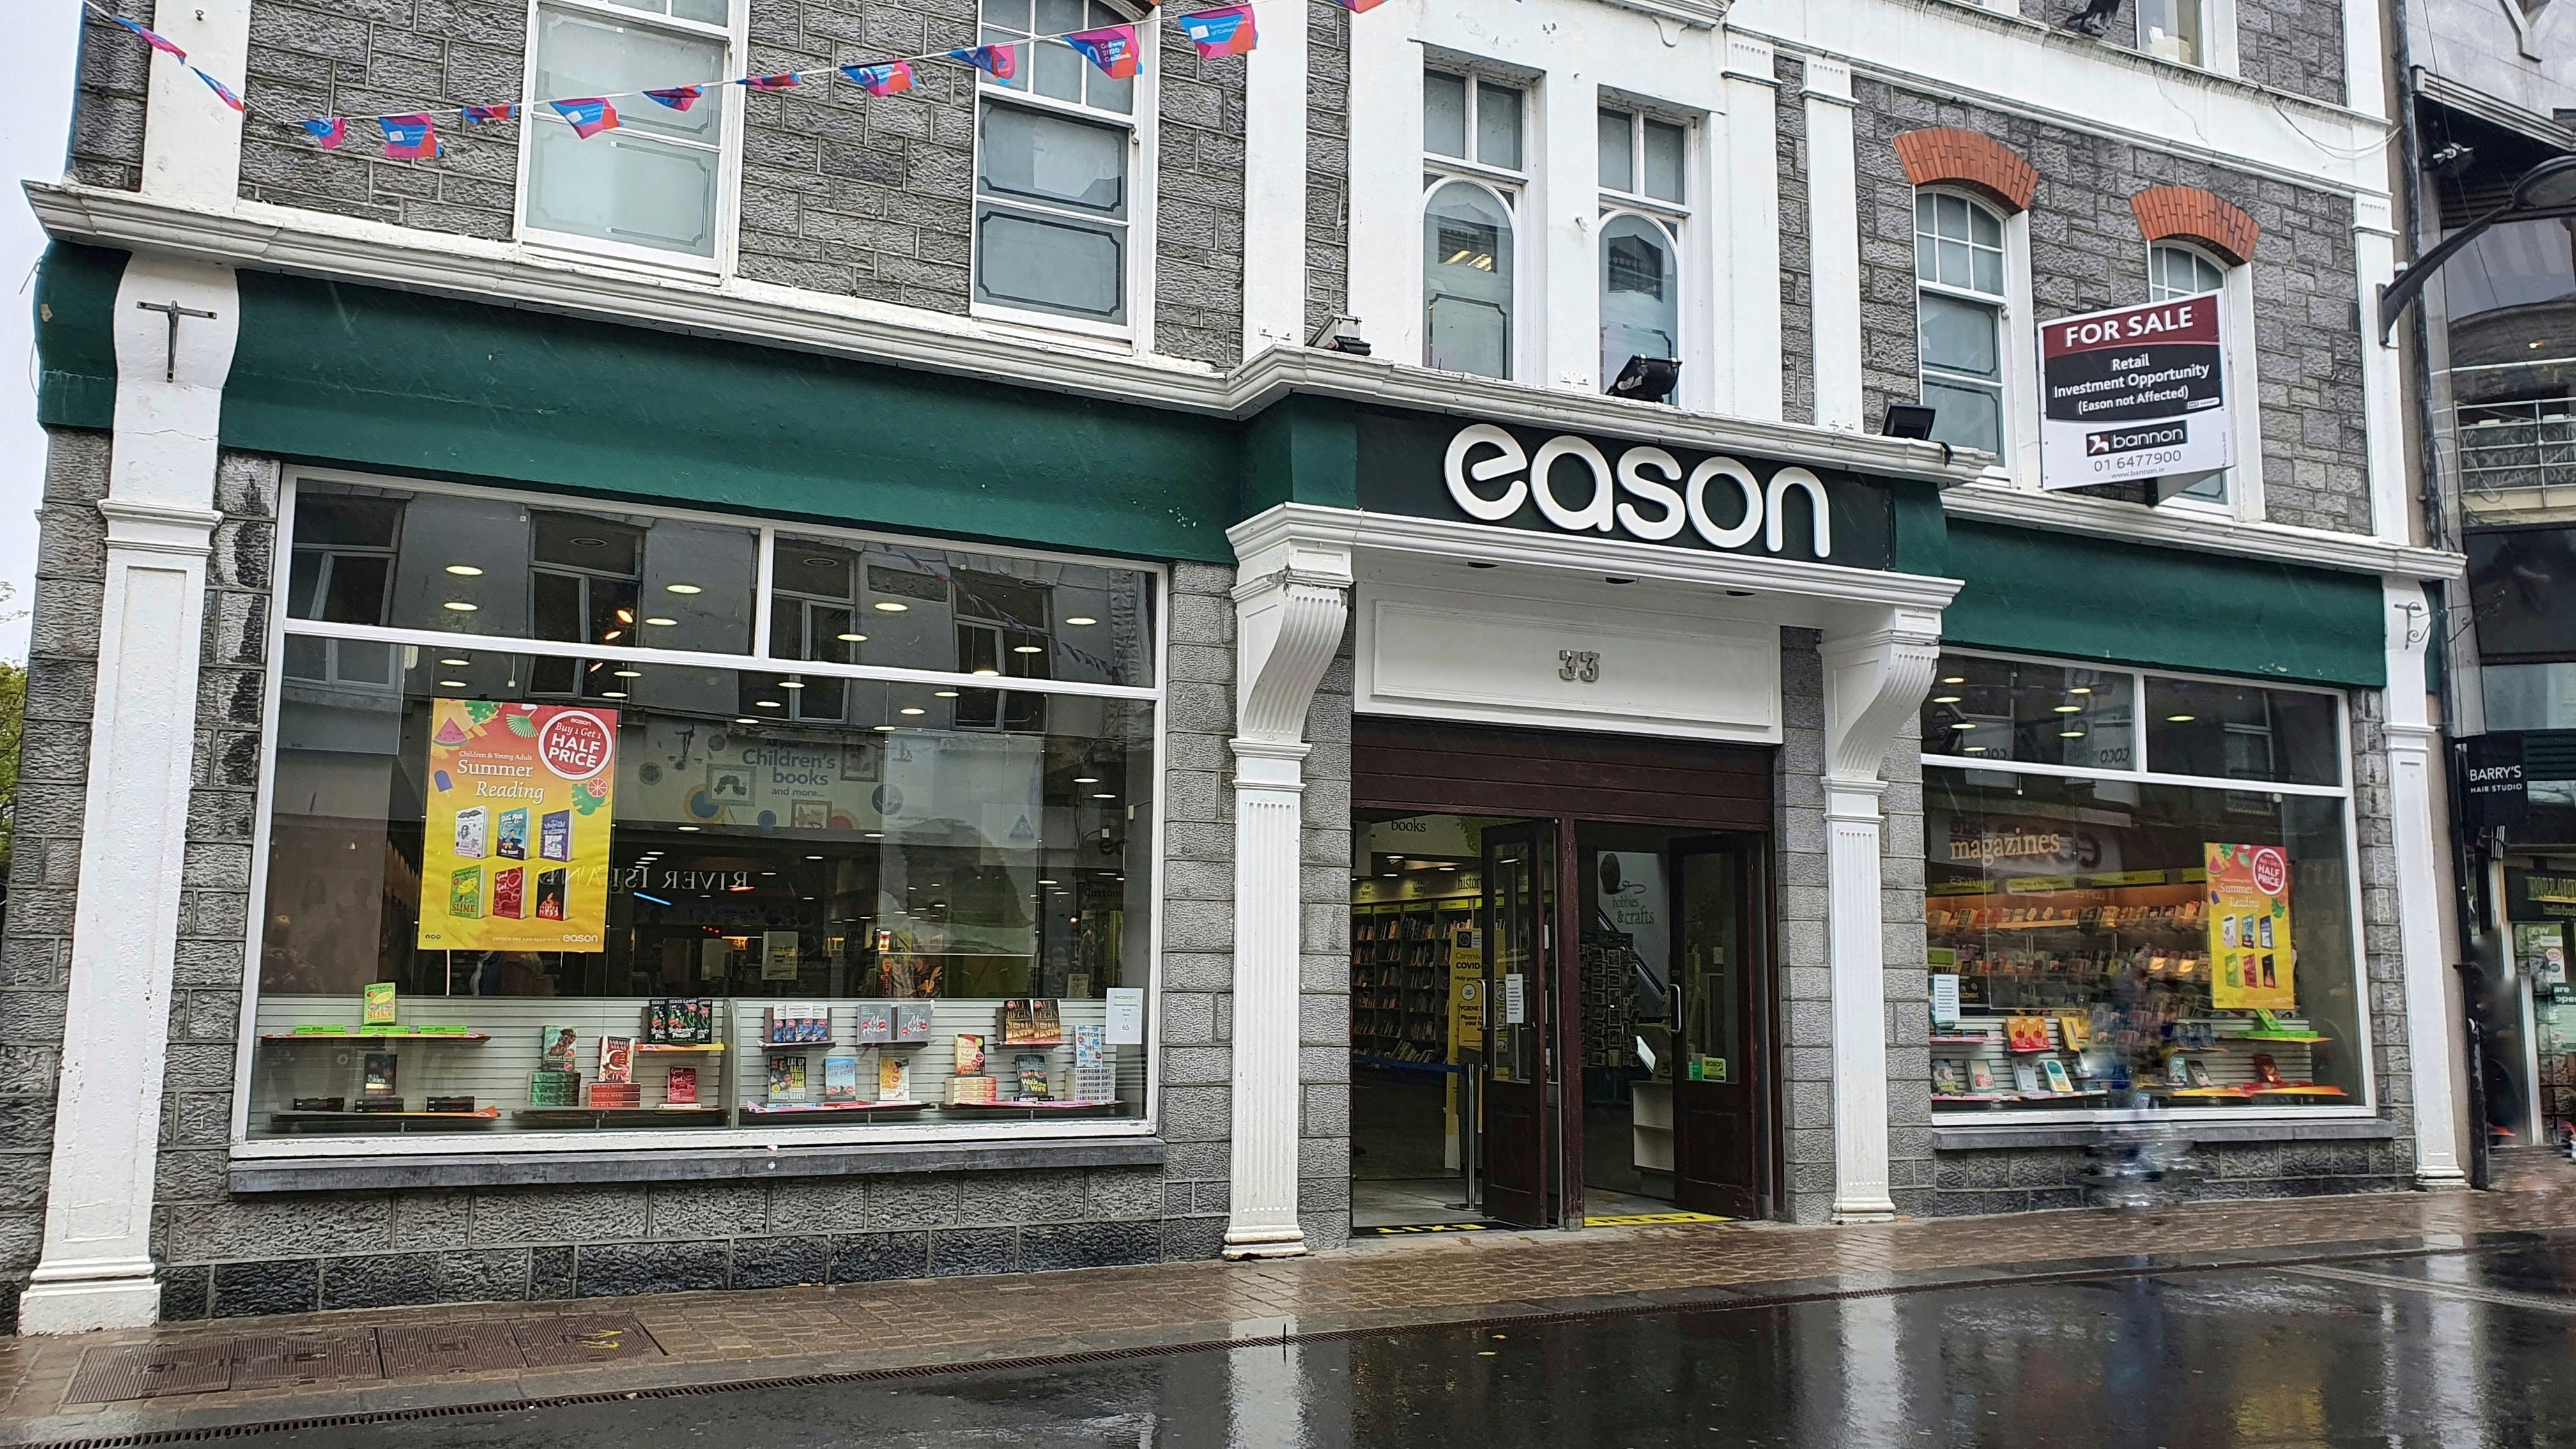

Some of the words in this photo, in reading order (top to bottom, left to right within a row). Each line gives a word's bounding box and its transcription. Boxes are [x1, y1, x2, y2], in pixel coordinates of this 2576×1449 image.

[1100, 40, 1126, 50] Galway
[2065, 320, 2120, 348] FOR
[2126, 306, 2194, 337] SALE
[2111, 353, 2150, 371] Retail
[2053, 376, 2124, 398] Investment
[2128, 364, 2210, 387] Opportunity
[2078, 395, 2113, 415] (Eason
[2115, 394, 2135, 406] not
[2137, 385, 2189, 403] Affected)
[2112, 427, 2184, 448] bannon
[2094, 459, 2110, 472] 01
[2117, 450, 2182, 470] 6477900
[2112, 466, 2165, 479] www.bannon.ie
[1445, 424, 1830, 558] eason
[1558, 649, 1600, 683] 33
[555, 722, 573, 735] Buy
[581, 728, 596, 738] Get
[551, 733, 601, 753] HALF
[494, 753, 514, 761] Young
[548, 747, 597, 768] PRICE
[742, 748, 836, 769] Children's
[457, 760, 533, 777] Summer
[773, 767, 829, 785] books
[2470, 765, 2522, 781] BARRY'S
[475, 781, 544, 804] Reading
[772, 786, 790, 796] and
[2471, 785, 2489, 793] HAIR
[2492, 783, 2522, 792] STUDIO
[1391, 818, 1426, 832] books
[1950, 827, 2060, 867] magazines
[2258, 864, 2280, 877] HALF
[1457, 873, 1481, 890] histor
[2220, 884, 2253, 893] Summer
[2258, 875, 2280, 887] PRICE
[452, 903, 475, 912] SLIME
[1613, 895, 1639, 907] hobbies
[1617, 910, 1623, 923] &
[1625, 905, 1654, 924] crafts
[563, 934, 598, 942] eason
[1007, 1010, 1031, 1019] BEGIN
[1034, 1010, 1058, 1019] BEGIN
